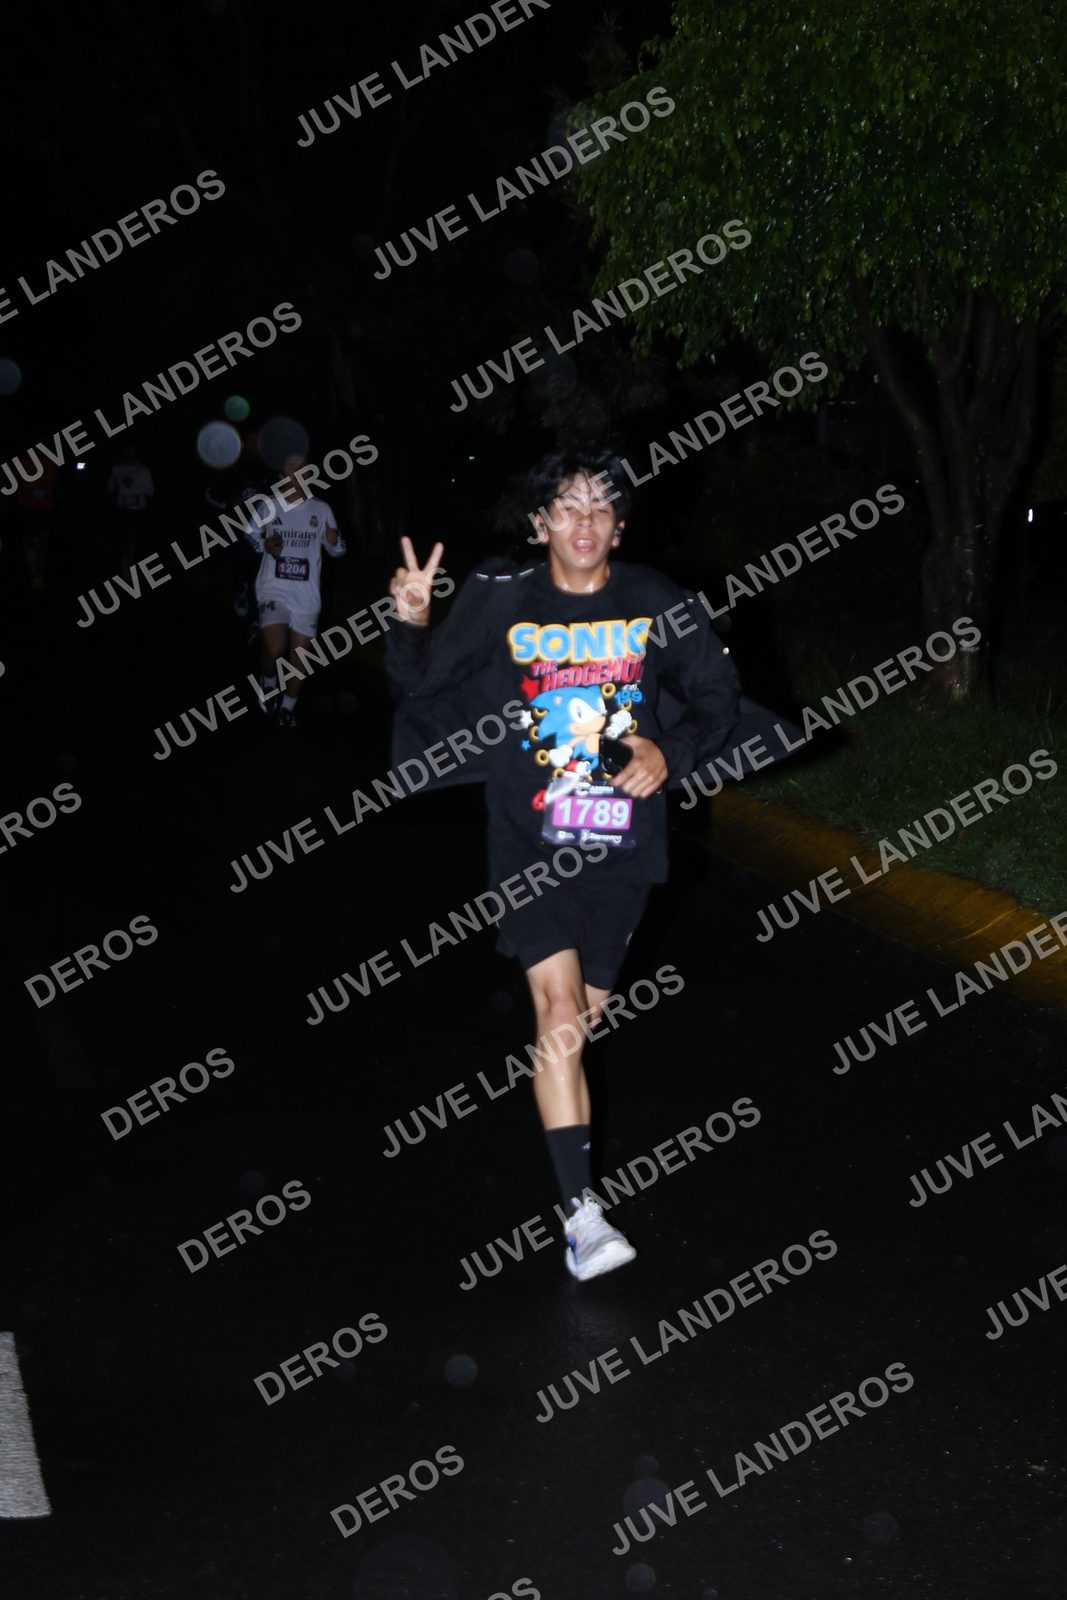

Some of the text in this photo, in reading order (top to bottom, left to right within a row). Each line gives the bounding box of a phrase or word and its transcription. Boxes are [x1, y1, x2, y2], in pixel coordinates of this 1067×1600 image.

[279, 563, 307, 575] 1204
[507, 617, 654, 665] SONIC
[532, 660, 558, 676] THE
[558, 797, 630, 827] 1789
